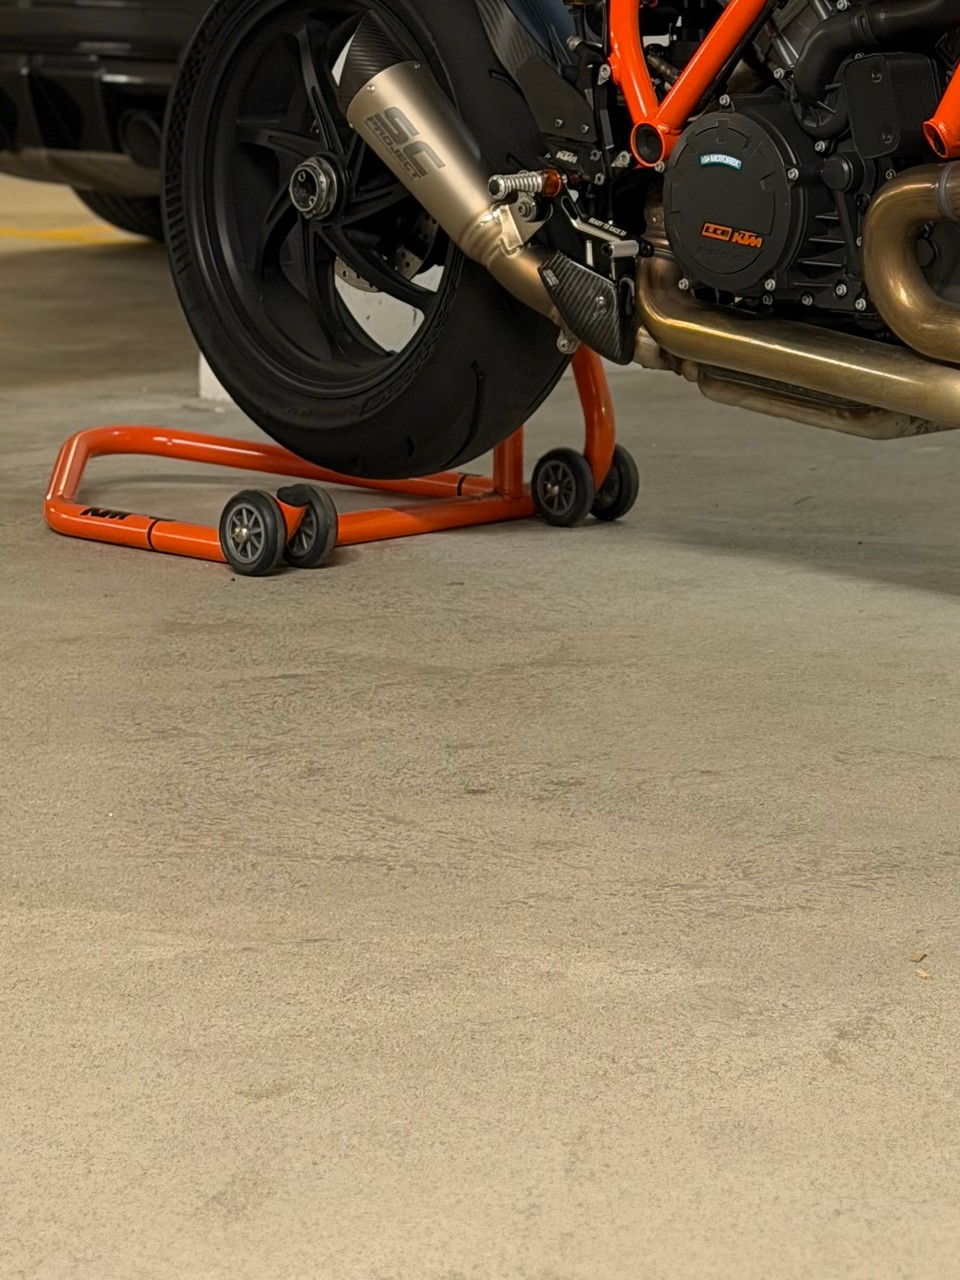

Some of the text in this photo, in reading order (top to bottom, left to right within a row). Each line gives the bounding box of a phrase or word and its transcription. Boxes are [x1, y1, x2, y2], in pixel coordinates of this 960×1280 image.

[364, 116, 422, 179] PROJECT
[375, 106, 446, 177] SC
[555, 149, 578, 165] KTM
[731, 231, 763, 248] KTM
